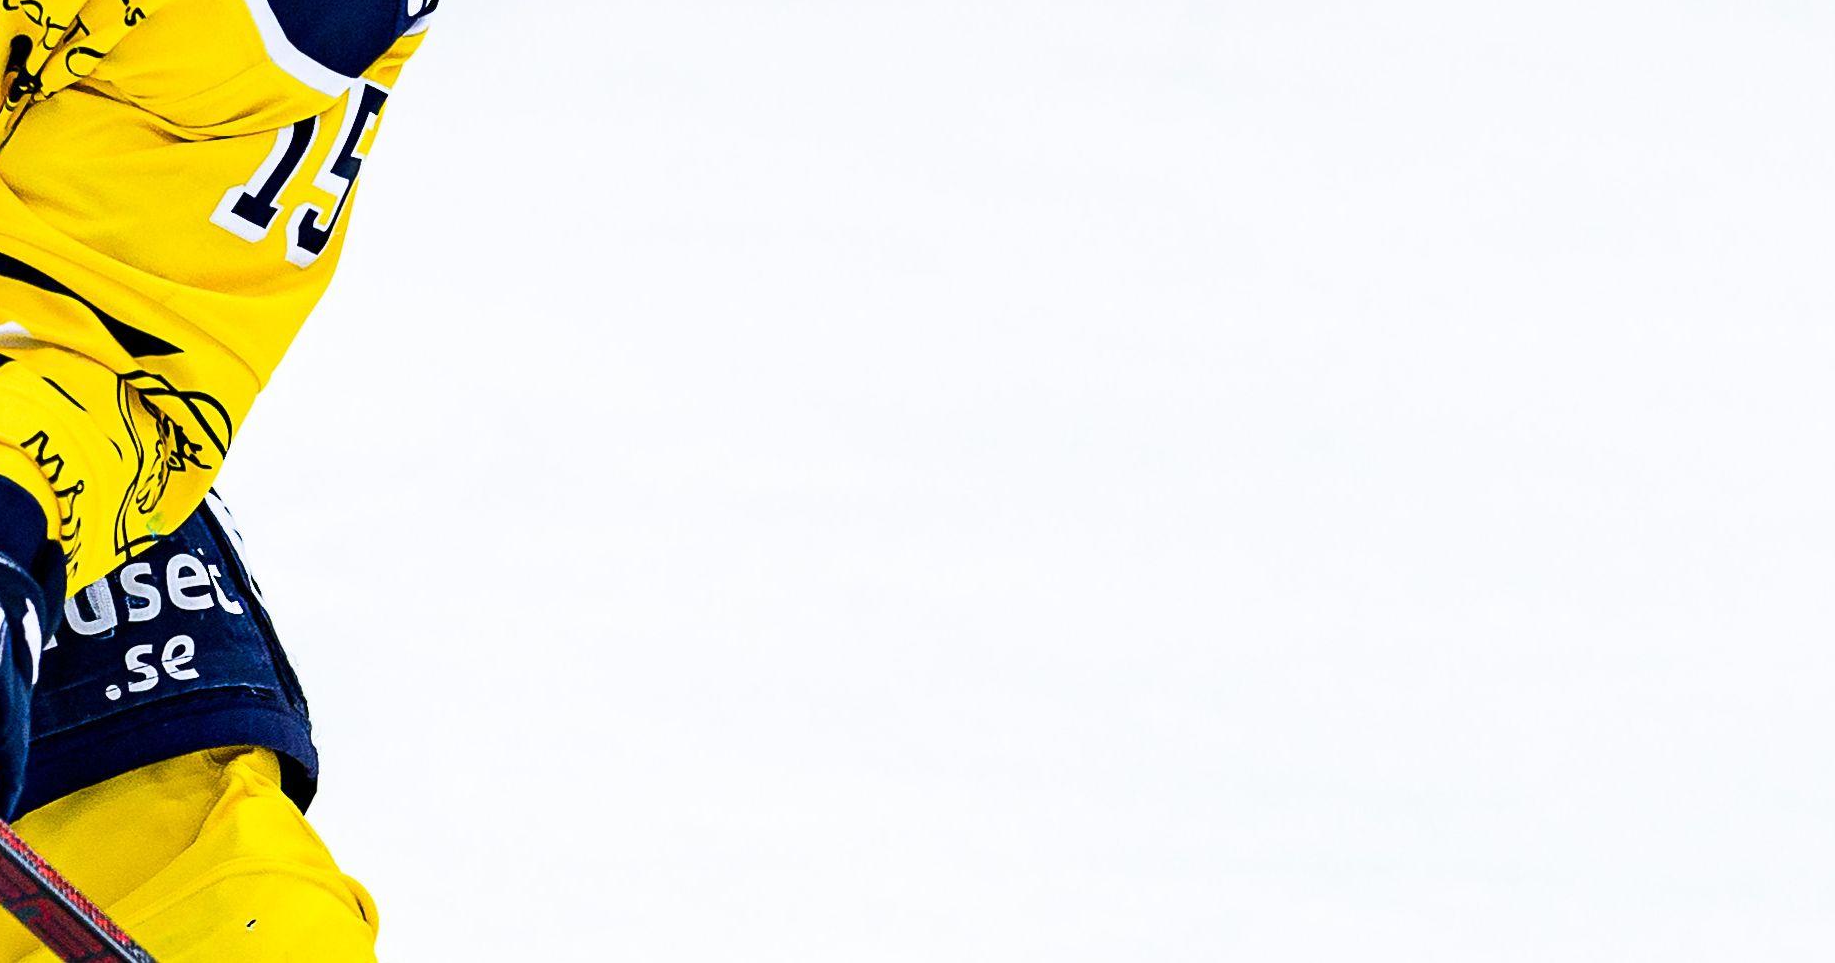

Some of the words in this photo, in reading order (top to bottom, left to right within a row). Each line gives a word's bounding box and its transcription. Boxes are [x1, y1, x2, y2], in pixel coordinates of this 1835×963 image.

[210, 79, 391, 269] 15
[51, 548, 244, 644] uset
[105, 634, 200, 700] .se
